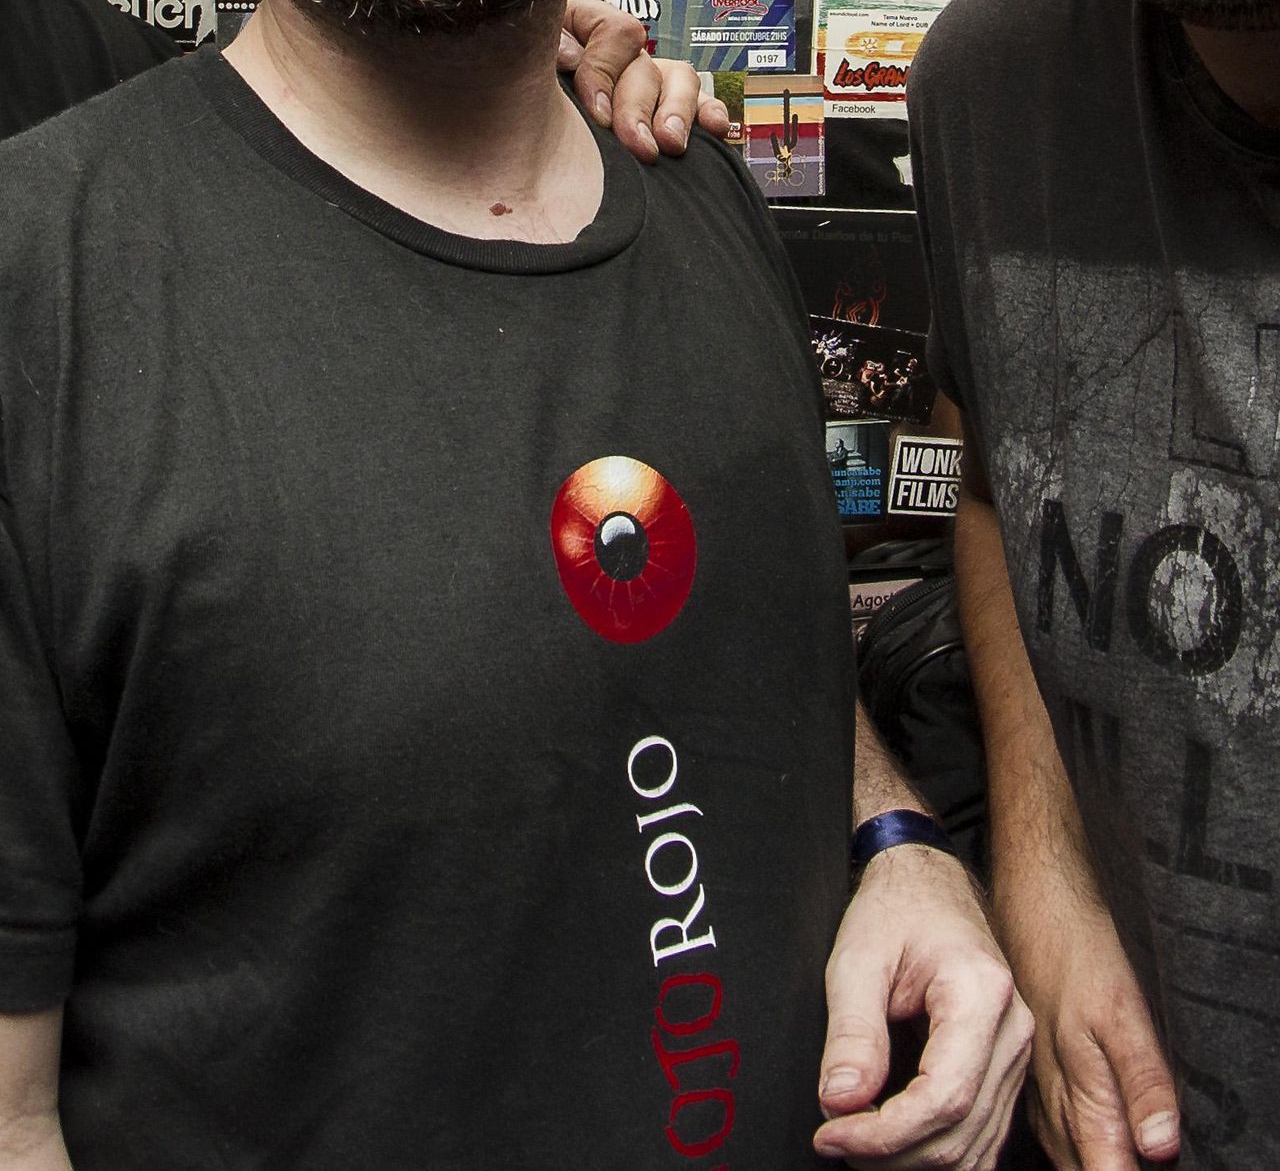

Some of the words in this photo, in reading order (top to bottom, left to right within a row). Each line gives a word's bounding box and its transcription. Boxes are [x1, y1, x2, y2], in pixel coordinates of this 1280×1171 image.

[722, 32, 730, 42] 17
[730, 32, 739, 41] DE
[740, 31, 771, 41] OCTUBRE
[756, 54, 779, 64] 0197
[832, 103, 876, 116] Facebook
[902, 445, 963, 477] WONK
[896, 480, 960, 509] FILMS
[1036, 497, 1246, 679] NO
[627, 734, 718, 968] ROJO
[651, 972, 741, 1159] OJO
